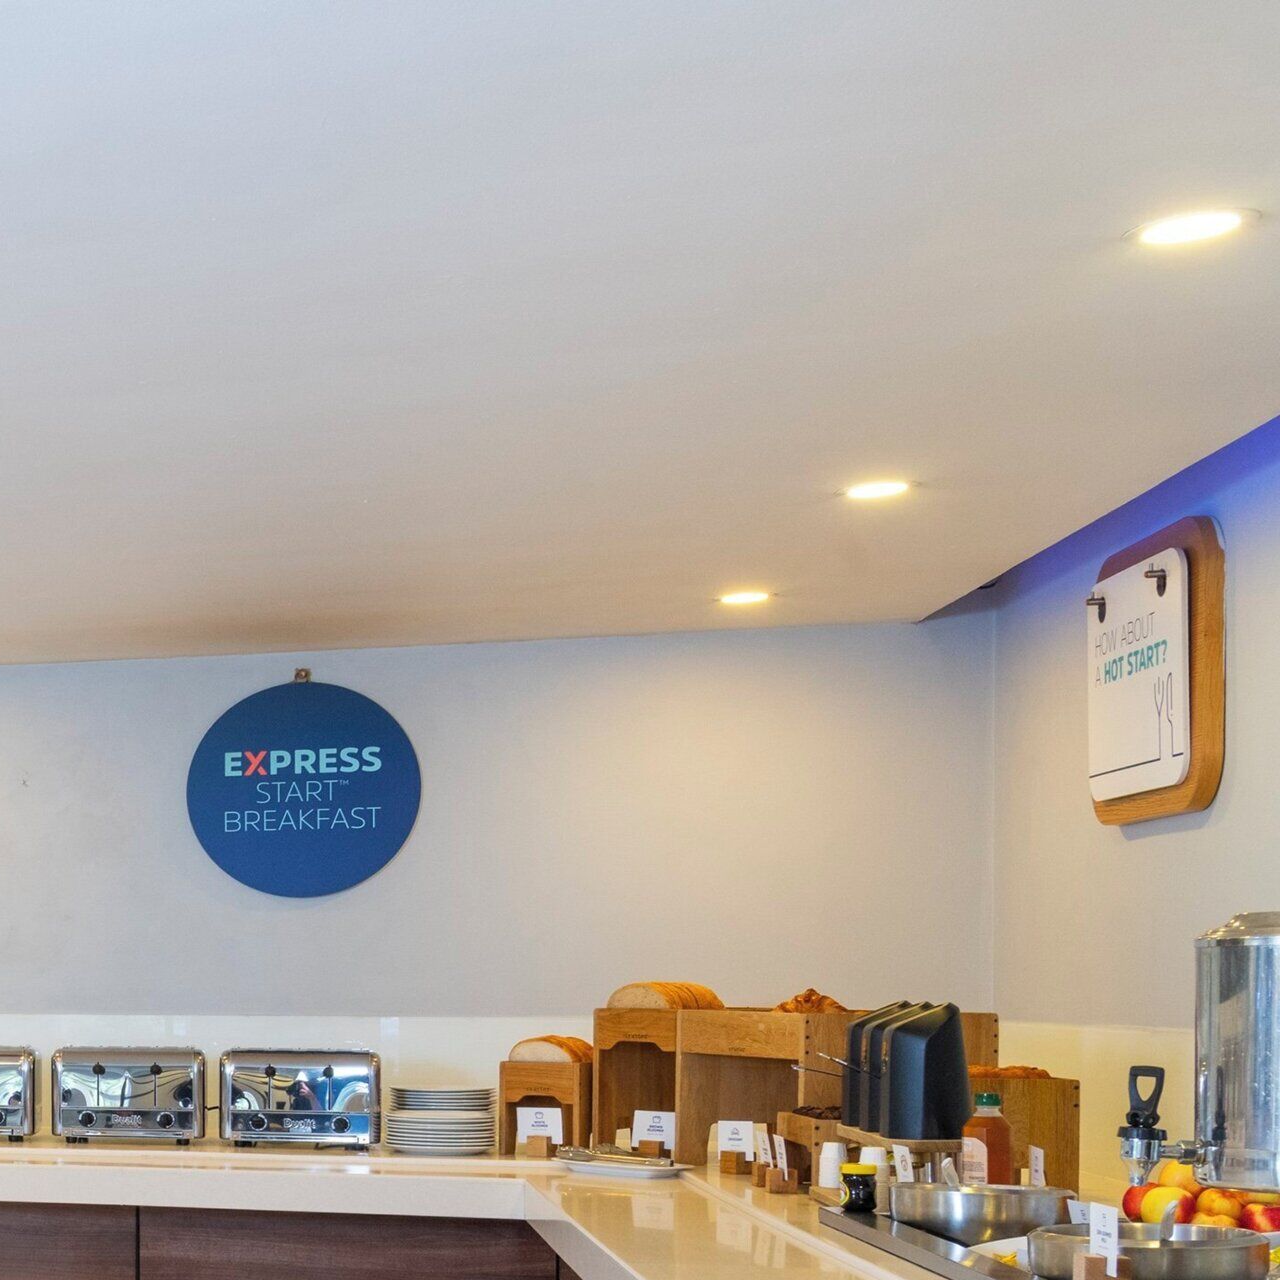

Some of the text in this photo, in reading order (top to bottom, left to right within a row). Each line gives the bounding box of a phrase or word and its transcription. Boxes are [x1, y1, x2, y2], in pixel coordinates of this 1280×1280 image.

[1095, 611, 1155, 658] HOW ABOUT
[1095, 639, 1168, 687] A HOT START?
[224, 746, 383, 777] EXPRESS
[224, 806, 382, 833] BREAKFAST
[112, 1114, 143, 1125] Dualit
[283, 1117, 316, 1130] Dualit
